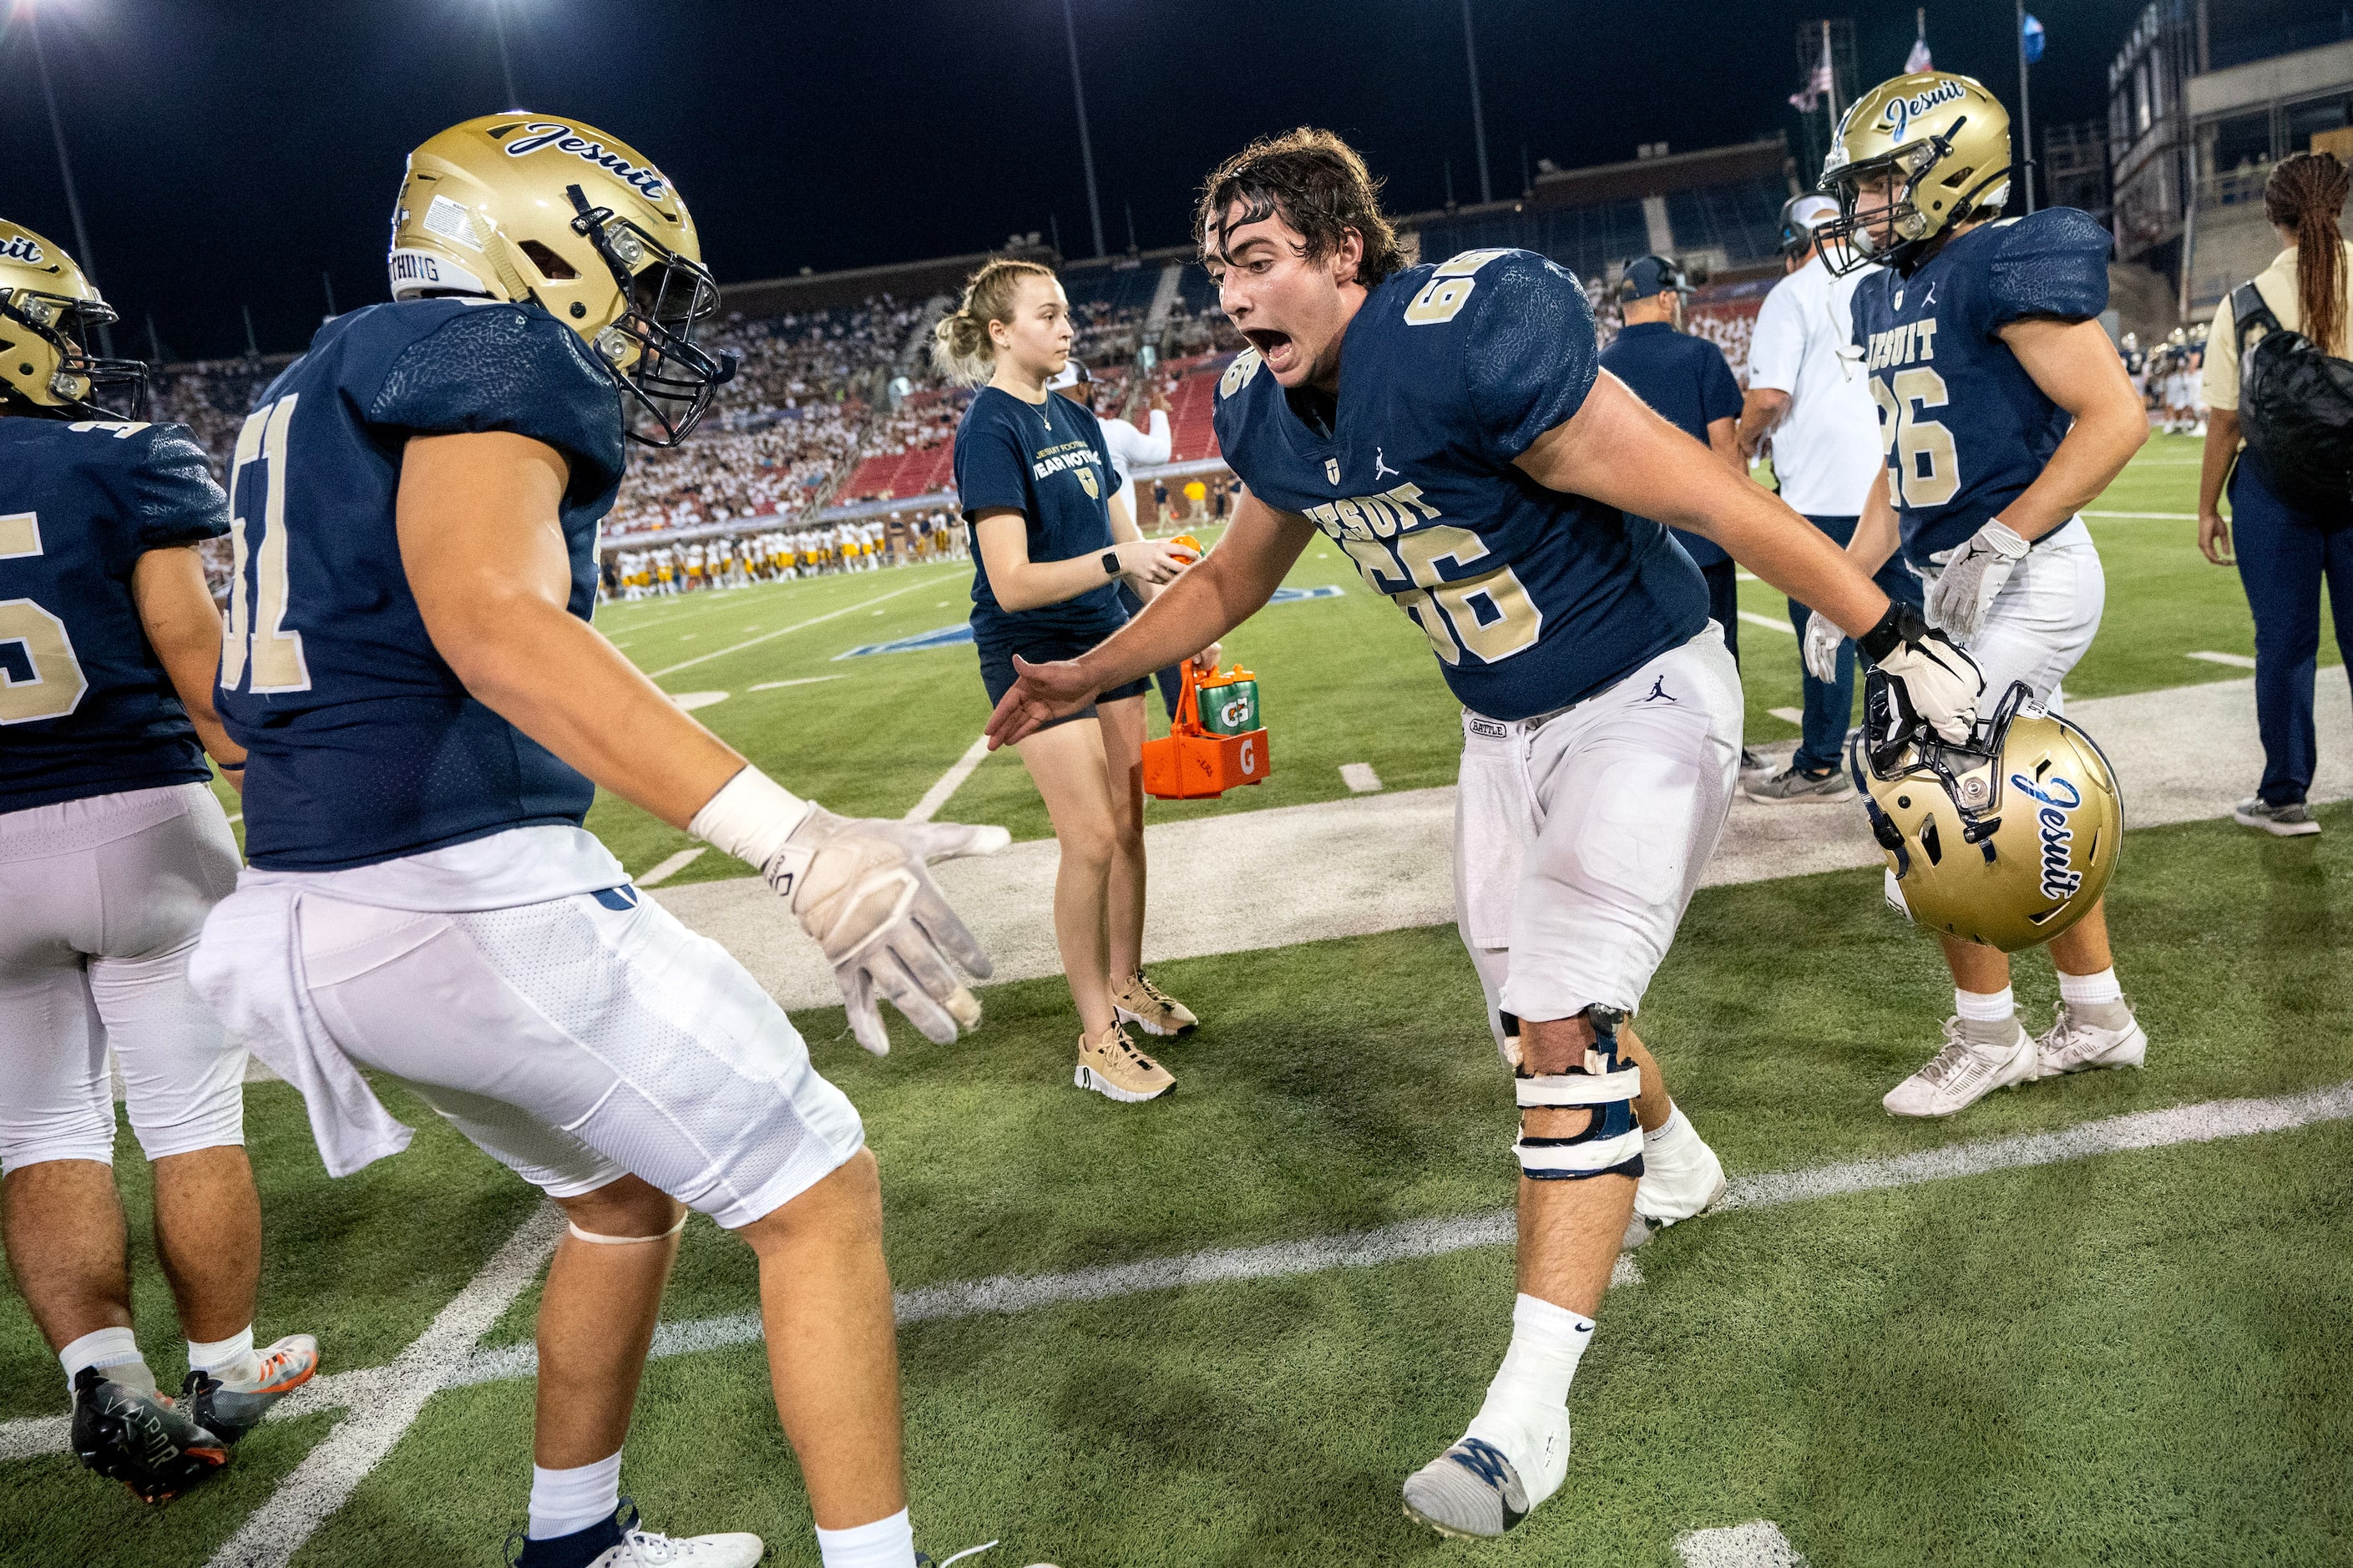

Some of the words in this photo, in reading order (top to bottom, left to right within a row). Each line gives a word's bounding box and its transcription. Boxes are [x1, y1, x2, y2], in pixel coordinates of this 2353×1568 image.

[1885, 82, 1966, 143] Jesuit
[504, 123, 669, 202] Jesuit
[1035, 446, 1060, 459] JESUIT
[1342, 524, 1544, 666] 66
[1240, 738, 1254, 776] G
[1472, 721, 1503, 736] BATTLE
[2008, 772, 2082, 901] Jesuit
[104, 1396, 180, 1469] VAPOR
